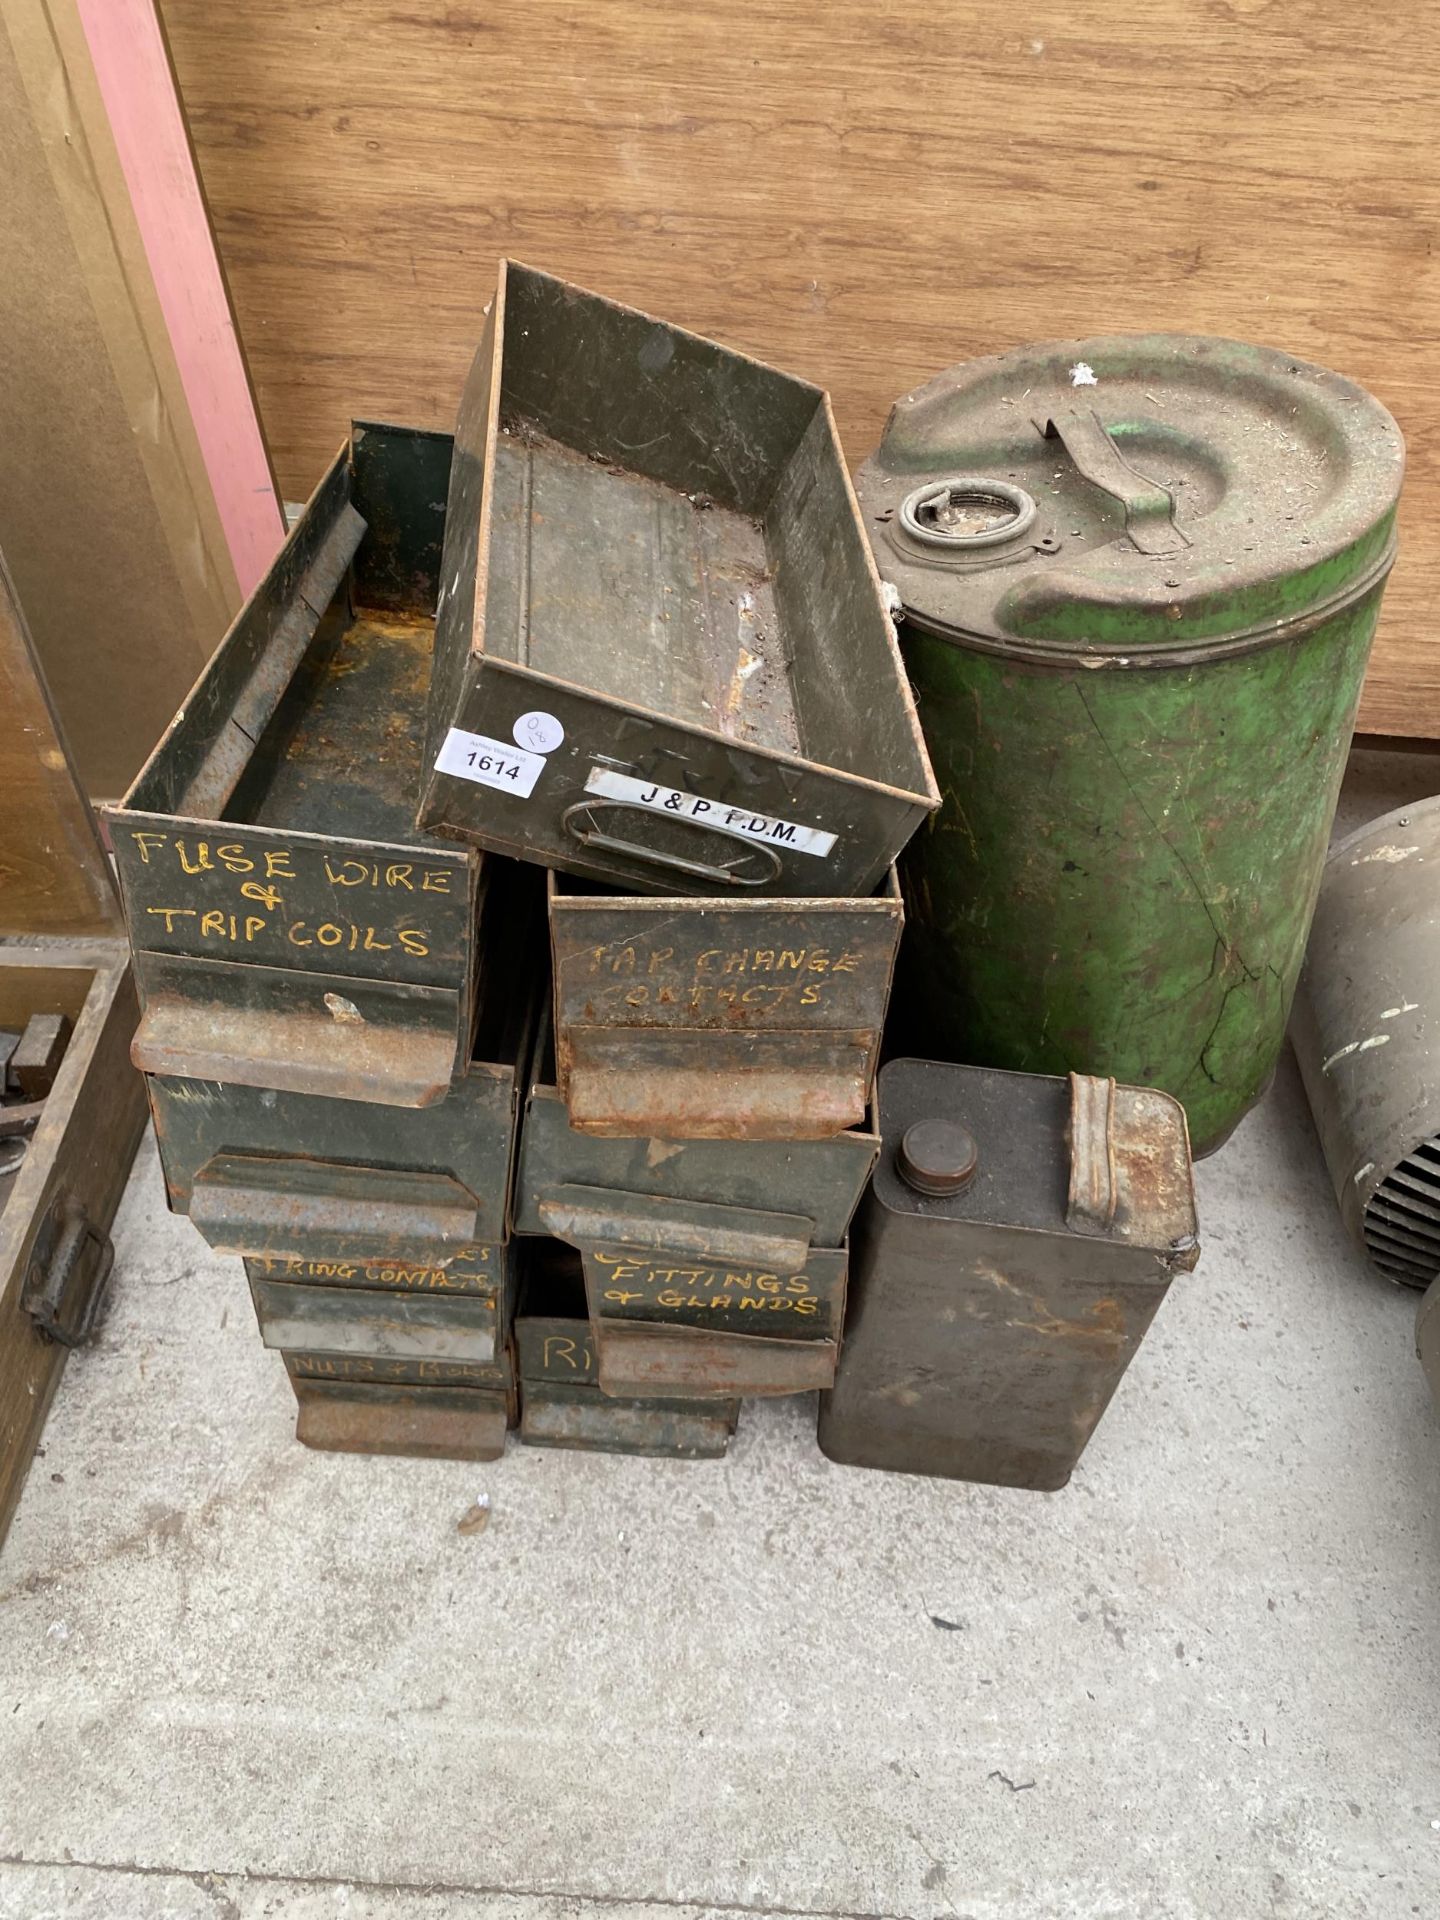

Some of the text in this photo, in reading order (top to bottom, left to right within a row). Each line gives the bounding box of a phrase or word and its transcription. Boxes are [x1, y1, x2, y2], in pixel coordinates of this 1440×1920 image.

[467, 752, 520, 780] 1614
[640, 788, 659, 803] J
[664, 793, 682, 812] &
[692, 799, 712, 816] P
[132, 832, 453, 893] FUSE WIRE
[241, 881, 282, 911] &
[147, 907, 430, 957] TRIP COILS
[589, 946, 864, 974] TAP CHANGE
[285, 1252, 358, 1279] RING
[611, 1266, 811, 1294] FITTINGS
[604, 1289, 819, 1315] & GLANDS
